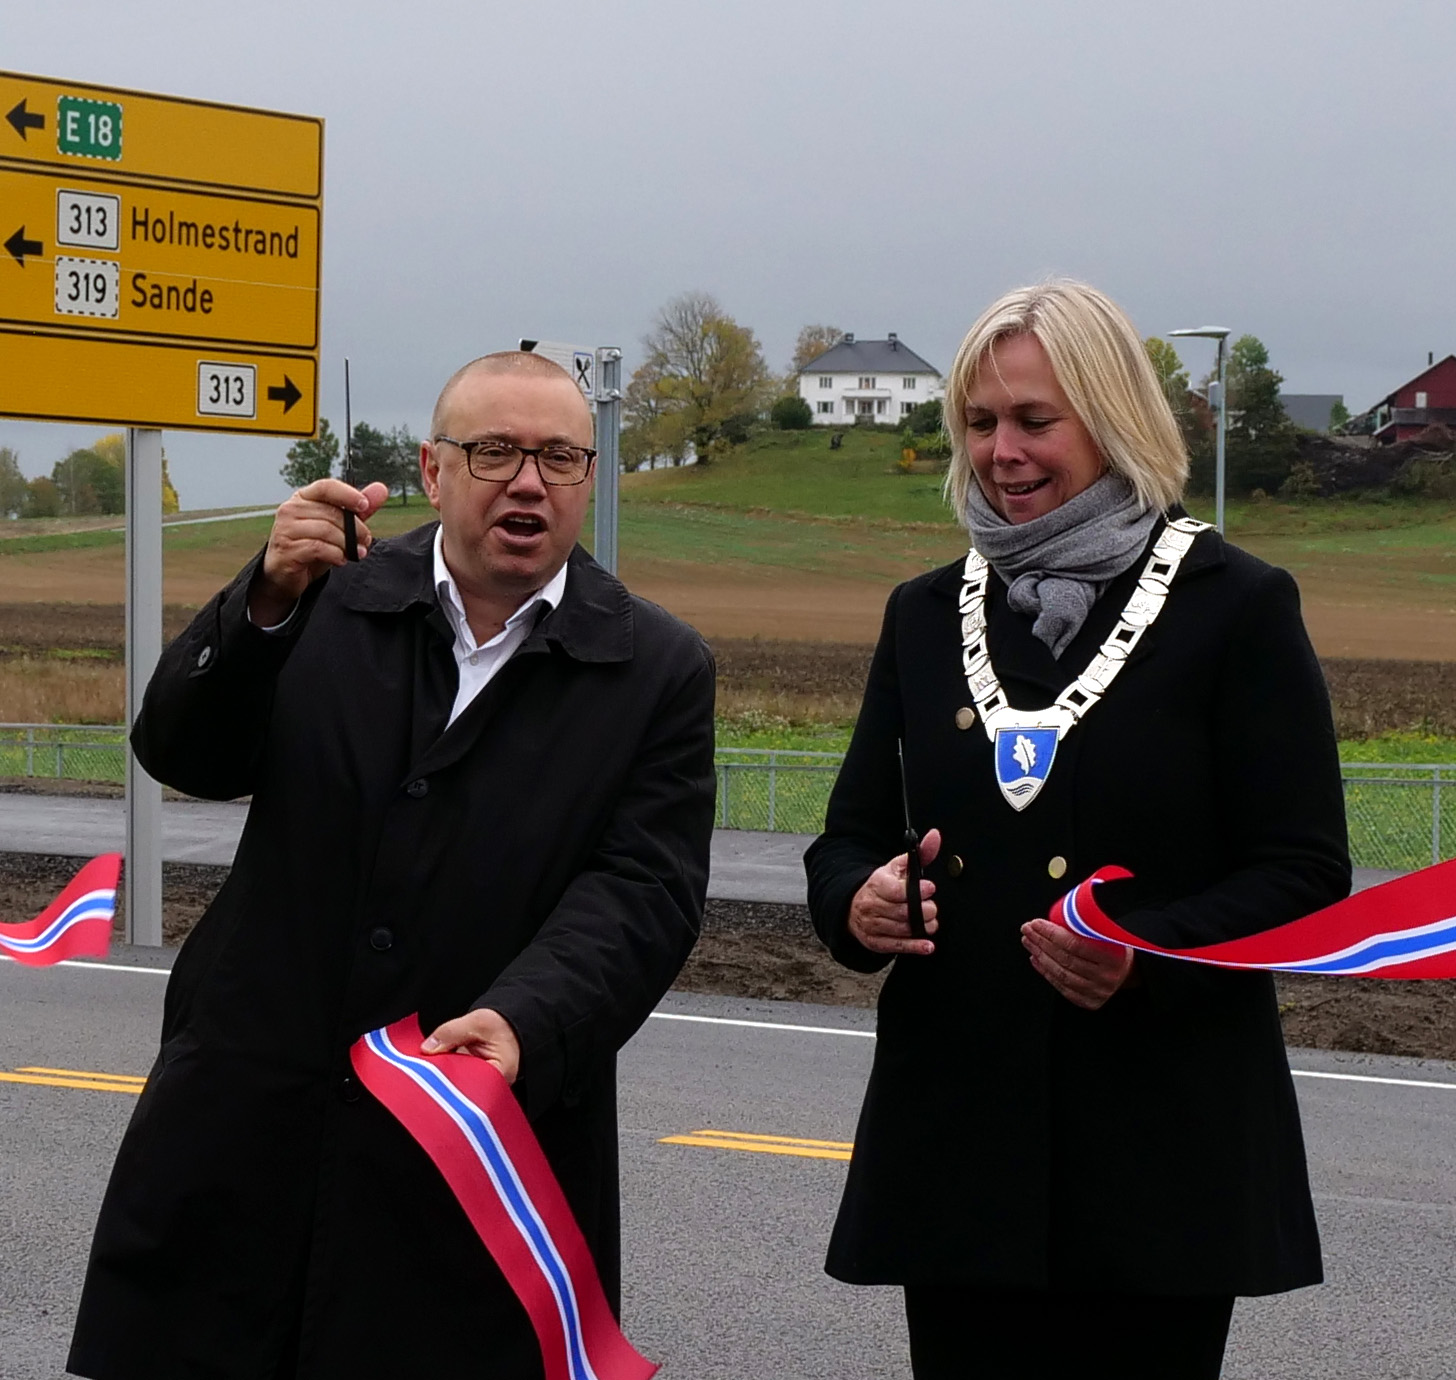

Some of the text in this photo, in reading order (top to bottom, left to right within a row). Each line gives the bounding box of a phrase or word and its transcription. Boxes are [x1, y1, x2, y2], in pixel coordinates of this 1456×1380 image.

[66, 110, 113, 147] E 18
[69, 203, 299, 259] 313 Holmestrand
[67, 270, 214, 315] 319 Sande
[209, 374, 244, 406] 313
